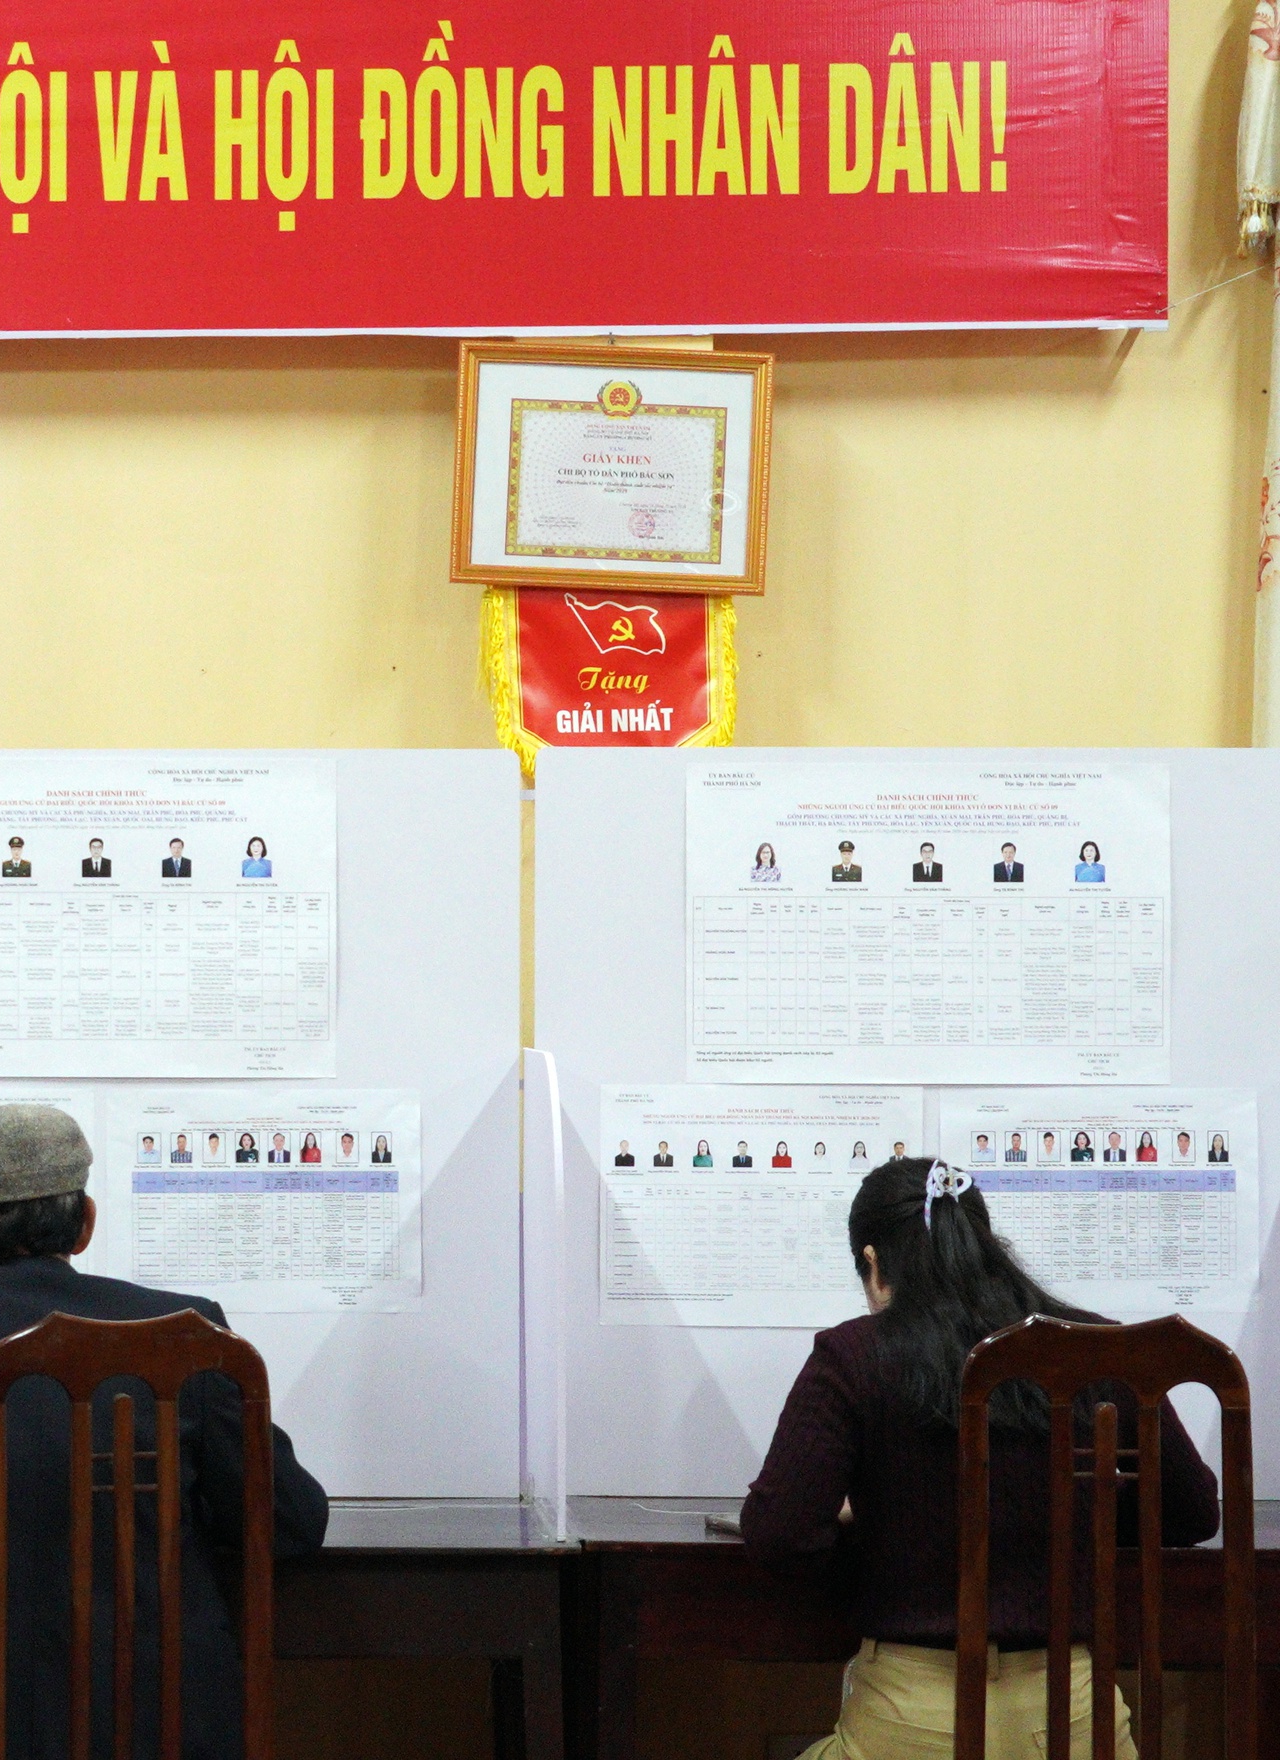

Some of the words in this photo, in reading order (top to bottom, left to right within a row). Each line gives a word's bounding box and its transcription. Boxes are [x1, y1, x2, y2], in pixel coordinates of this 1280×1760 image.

[94, 41, 188, 201] VÀ
[215, 40, 333, 231] HỘI
[360, 21, 563, 200] ĐỒNG
[593, 35, 799, 196] NHÂN
[829, 33, 1006, 193] DÂN!
[583, 452, 613, 463] GIẤY
[617, 455, 652, 465] KHEN
[578, 666, 650, 694] Tặng
[556, 701, 603, 733] GIẢI
[611, 700, 673, 733] NHẤT
